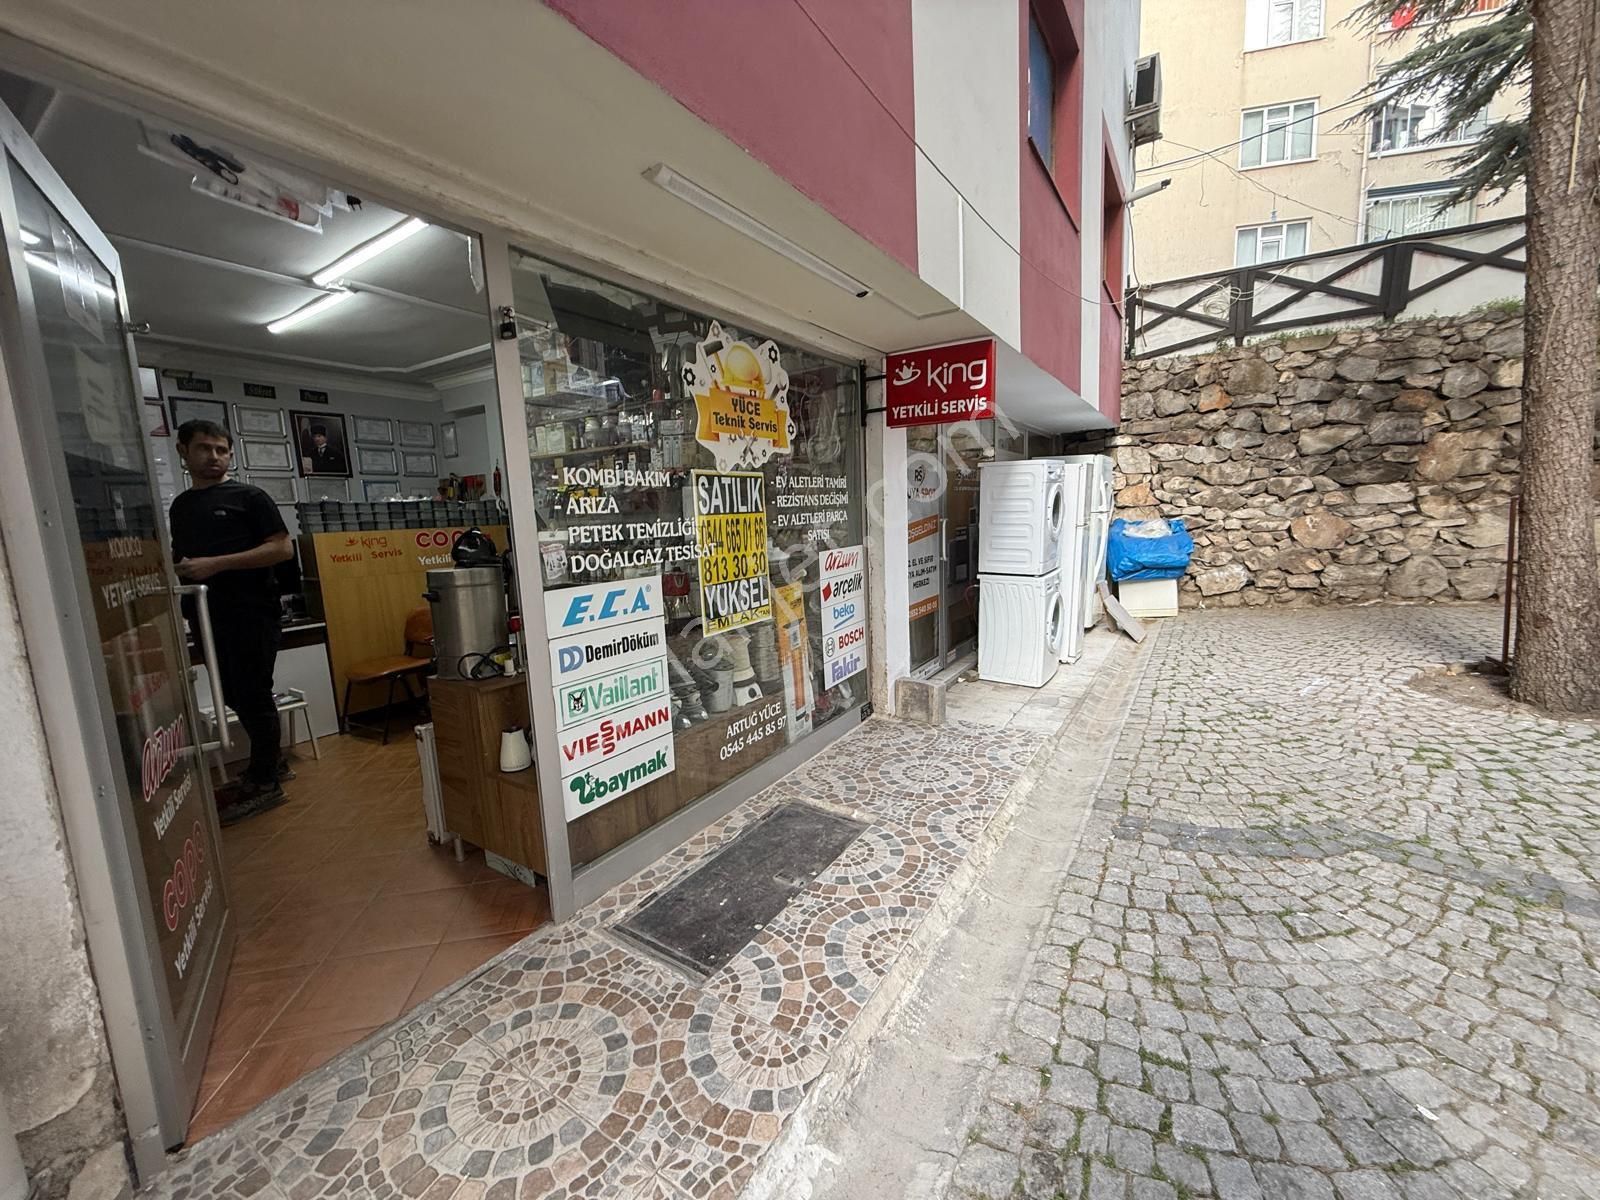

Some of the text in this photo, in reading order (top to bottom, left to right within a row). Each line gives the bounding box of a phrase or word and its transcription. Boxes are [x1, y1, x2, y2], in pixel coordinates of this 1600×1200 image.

[927, 359, 987, 393] king
[731, 396, 761, 416] YÜCE
[892, 394, 987, 419] YETKİLİ SERVİS
[713, 412, 778, 433] Teknik Servis
[563, 465, 671, 487] KOMBİ BAKIM
[776, 475, 787, 488] EV
[789, 474, 824, 488] ALETLERİ
[566, 494, 620, 515] ARIZA
[698, 476, 763, 514] SATILIK
[778, 514, 789, 526] EV
[791, 510, 825, 525] ALETLERİ
[361, 536, 387, 549] king
[568, 524, 624, 544] PETEK
[330, 549, 402, 564] Yetkili Servis
[571, 548, 663, 573] DOĞALGAZ
[704, 551, 766, 584] 813 30 30
[825, 551, 859, 571] arzum
[833, 573, 863, 598] arçelik
[833, 603, 855, 620] beko
[585, 632, 659, 663] DemirDöküm
[839, 627, 864, 650] BOSCH
[831, 654, 860, 682] Fakir
[588, 667, 658, 710] Vaillant
[726, 702, 782, 739] ARTUĞ YÜCE
[719, 715, 787, 761] 0545 445 85 97
[592, 750, 667, 798] baymak
[153, 794, 175, 840] Yetkili
[174, 915, 197, 979] Yetkili
